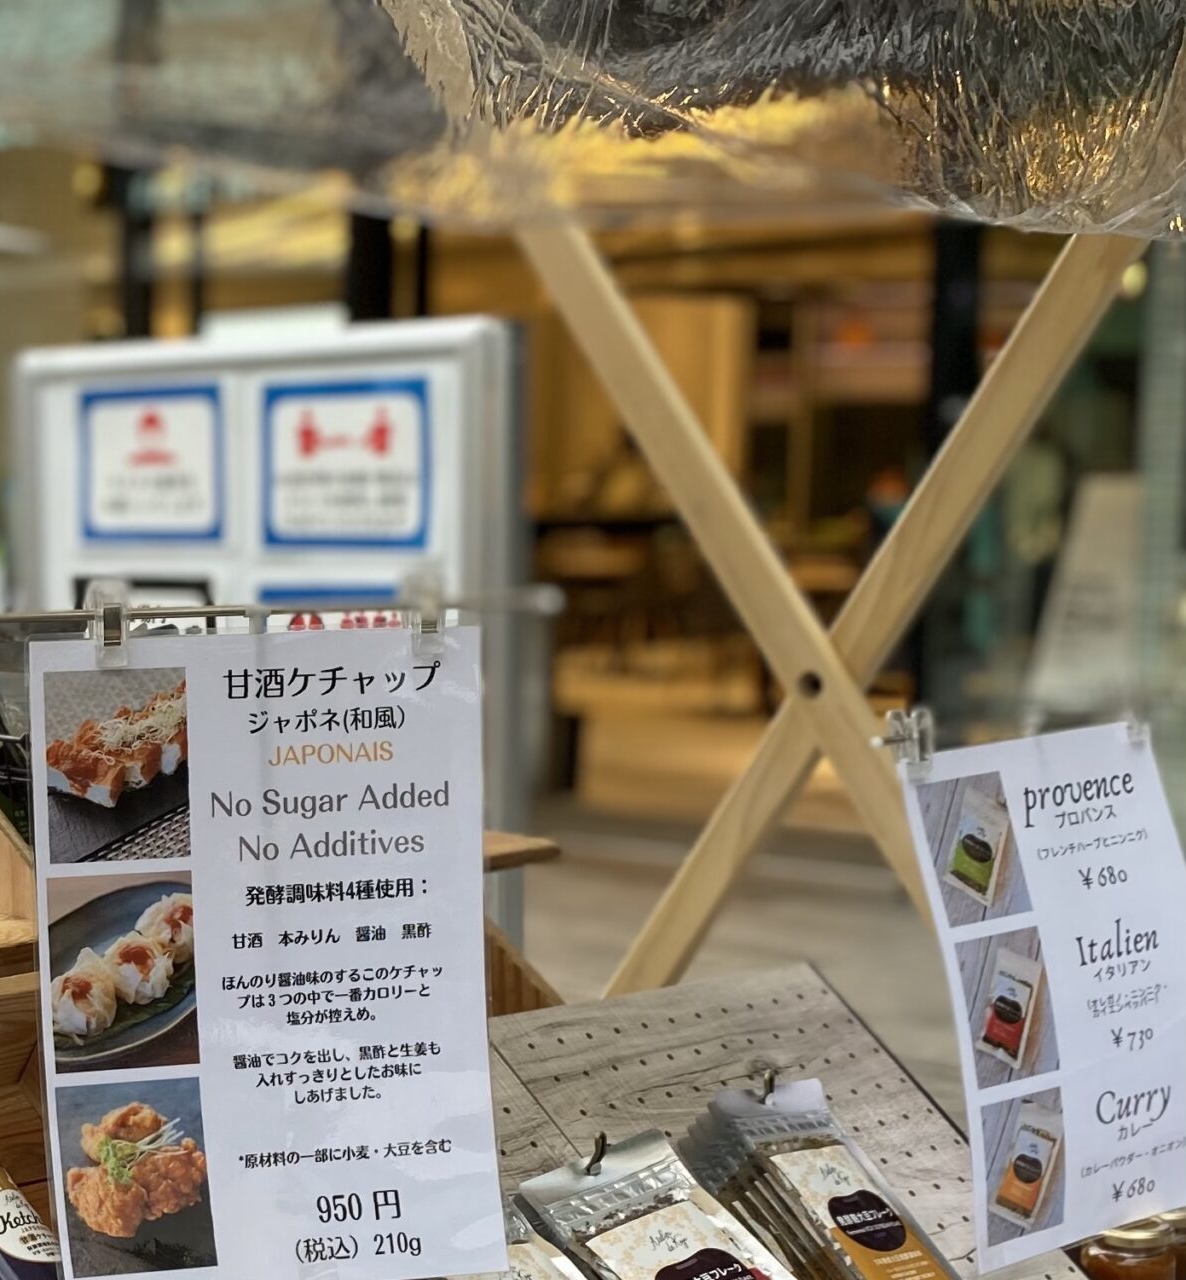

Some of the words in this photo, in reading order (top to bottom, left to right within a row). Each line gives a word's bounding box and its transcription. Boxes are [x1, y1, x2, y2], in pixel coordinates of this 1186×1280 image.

[223, 661, 440, 700] 甘酒ケチャップ
[268, 741, 393, 766] JAPONAIS
[210, 791, 251, 818] No
[262, 789, 348, 819] Sugar
[358, 781, 450, 811] Added
[1024, 773, 1134, 828] provence
[1055, 805, 1116, 828] プロバンス
[239, 835, 279, 862] No
[290, 830, 425, 860] Additives
[232, 932, 263, 949] 甘酒
[278, 928, 340, 946] 本みりん
[355, 926, 386, 942] 醤油
[401, 922, 432, 940] 黒酢
[1075, 918, 1159, 966] Italien
[222, 965, 443, 990] ほんのり醤油味のするこのケチャッ
[1093, 959, 1151, 982] イタリアン
[286, 1006, 377, 1026] 塩分が控えめ。
[233, 1041, 441, 1070] 醤油でコクを出し、黒酢と生姜も
[256, 1062, 422, 1088] 入れすっきりとしたお味に
[294, 1085, 382, 1104] しあげました。
[1096, 1085, 1171, 1124] Curry
[1117, 1120, 1153, 1141] カレー
[316, 1192, 362, 1223] 950
[373, 1189, 401, 1220] 円
[374, 1232, 421, 1256] 210g
